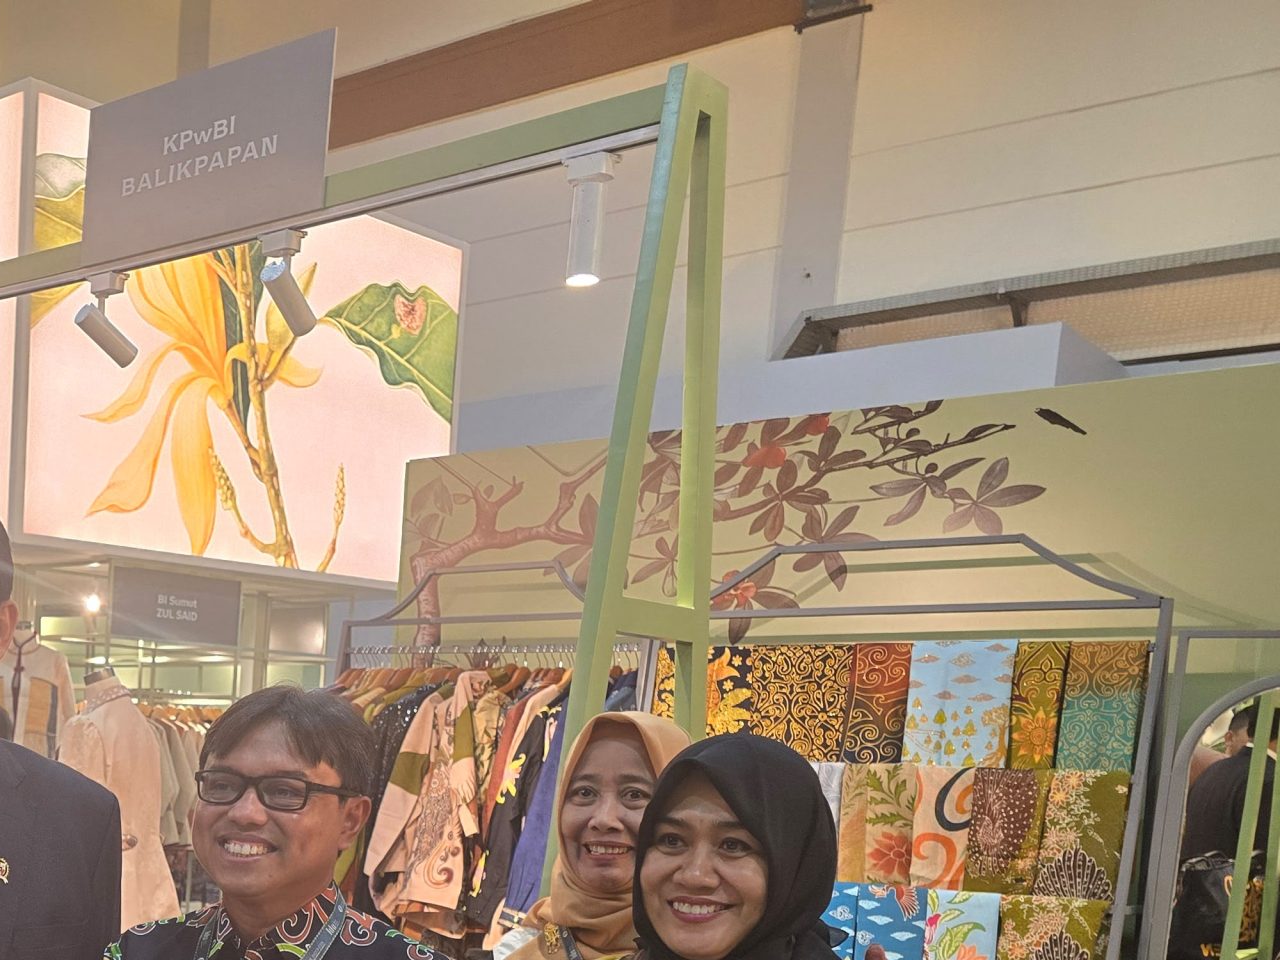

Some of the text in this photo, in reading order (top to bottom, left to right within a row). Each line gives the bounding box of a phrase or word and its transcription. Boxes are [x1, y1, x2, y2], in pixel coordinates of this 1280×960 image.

[162, 115, 237, 156] KPwBI
[121, 134, 279, 197] BALIKPAPAN
[156, 607, 174, 619] ZUL
